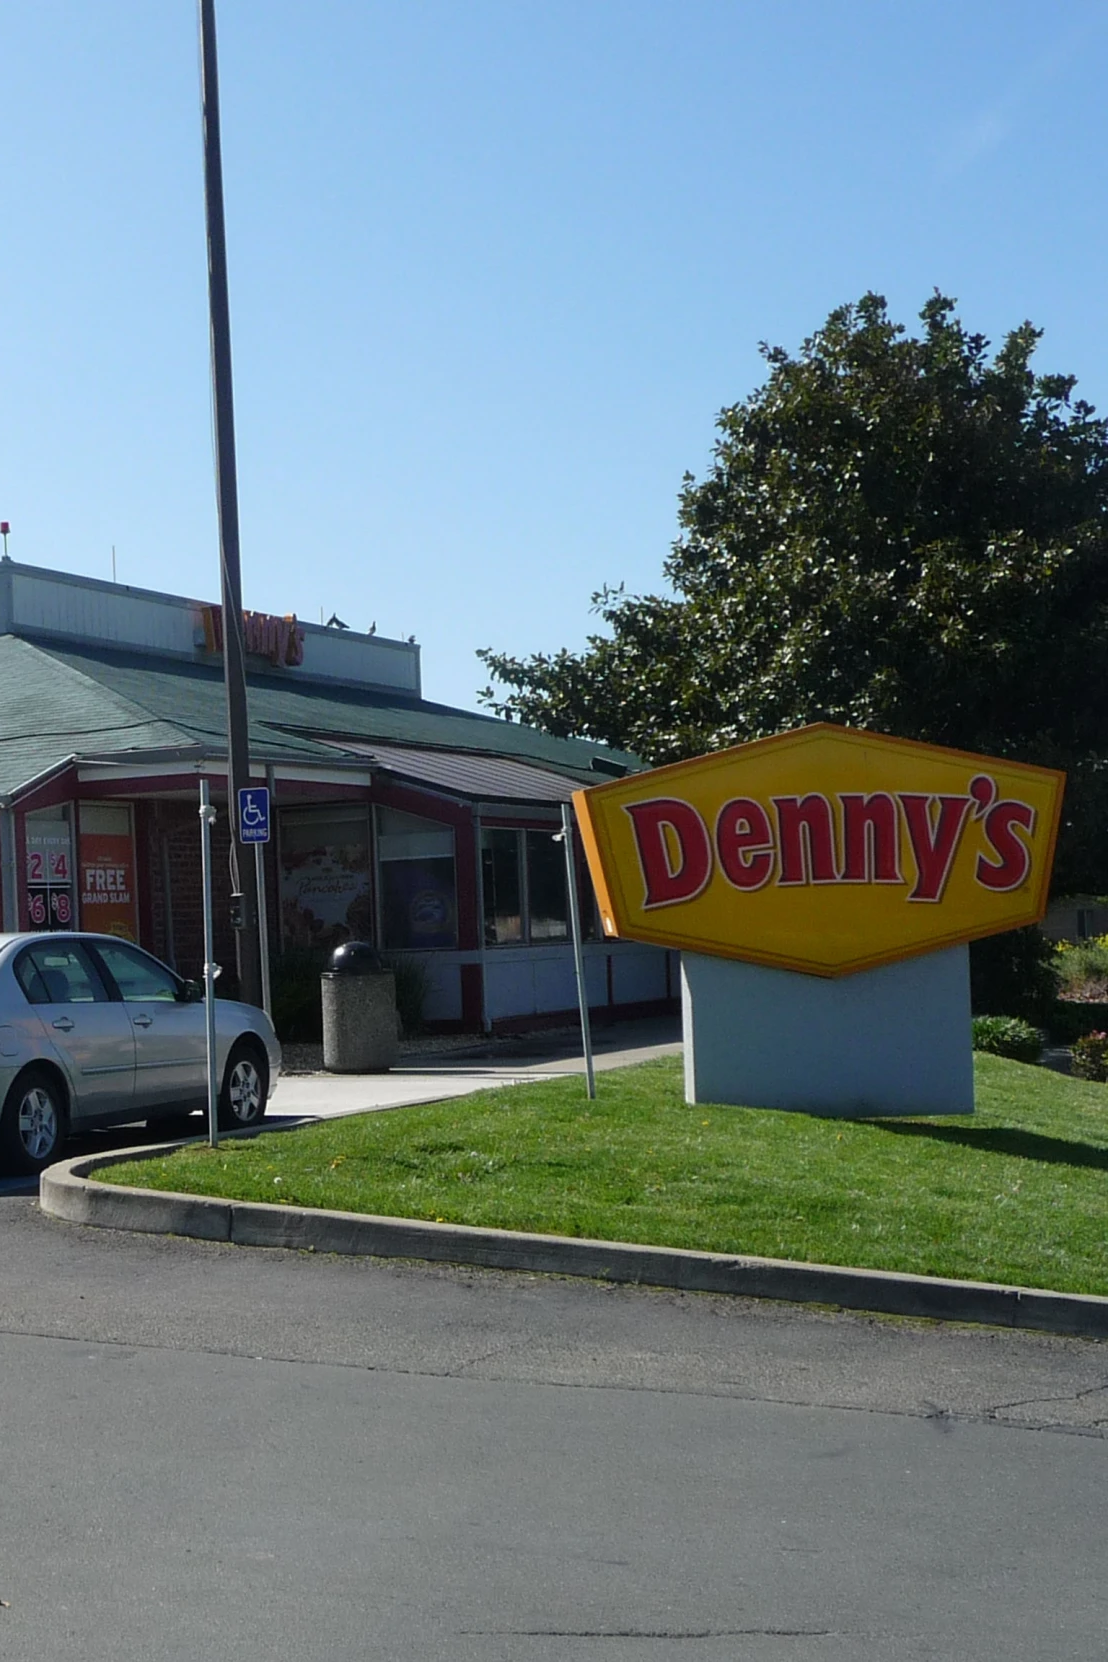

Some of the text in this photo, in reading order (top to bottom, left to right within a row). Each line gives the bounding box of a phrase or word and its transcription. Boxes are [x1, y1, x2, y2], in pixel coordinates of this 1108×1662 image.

[242, 828, 268, 838] PARKING
[623, 773, 1035, 911] Denny's
[85, 868, 127, 891] FREE
[51, 892, 71, 923] $8
[81, 892, 131, 904] GRAND SLAM
